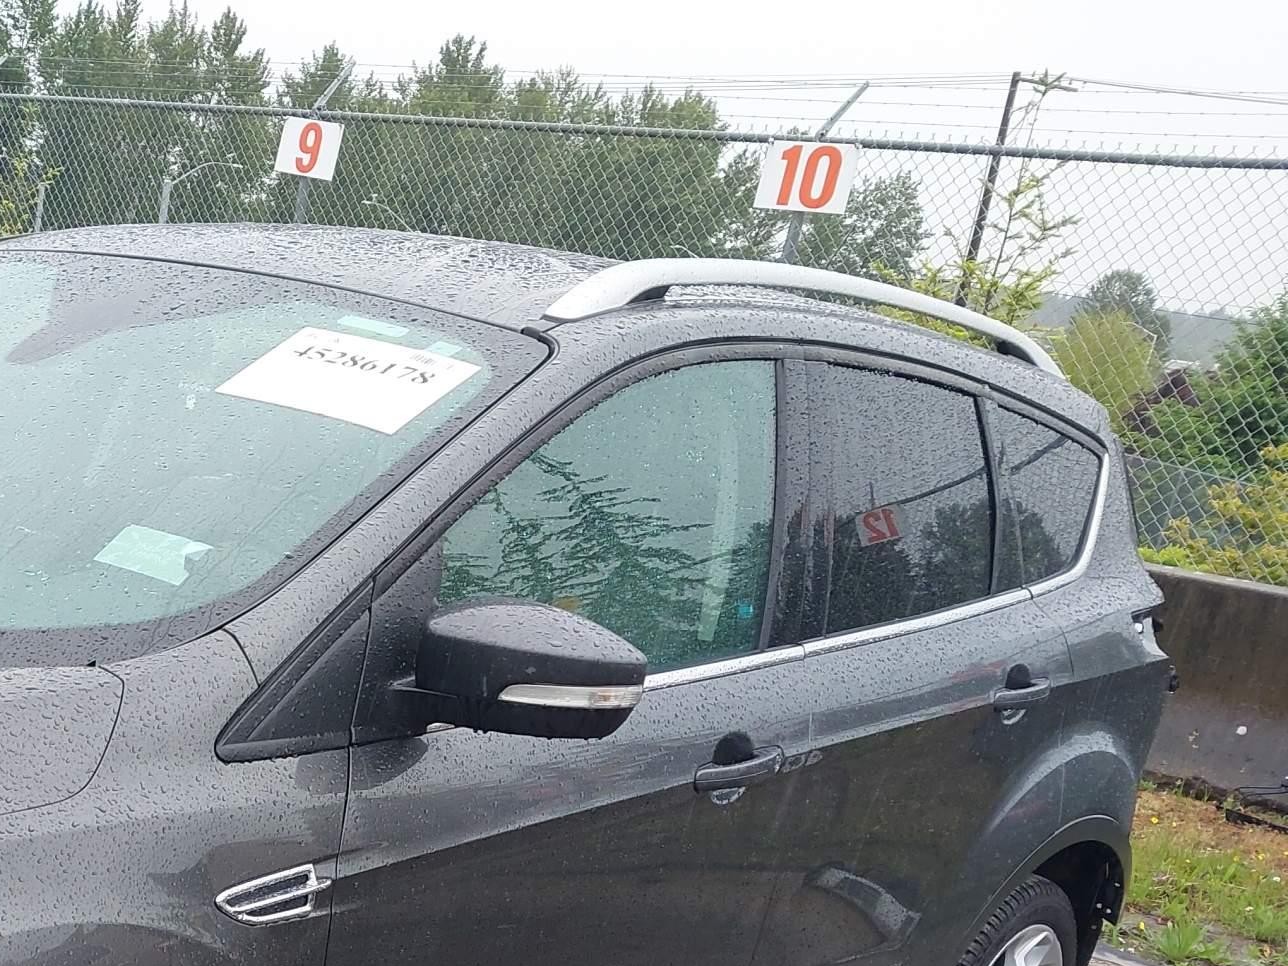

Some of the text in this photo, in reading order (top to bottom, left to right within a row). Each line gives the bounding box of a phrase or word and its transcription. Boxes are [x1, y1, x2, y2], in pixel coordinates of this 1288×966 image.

[295, 122, 323, 174] 9
[776, 144, 843, 209] 10
[294, 344, 436, 385] 45286178
